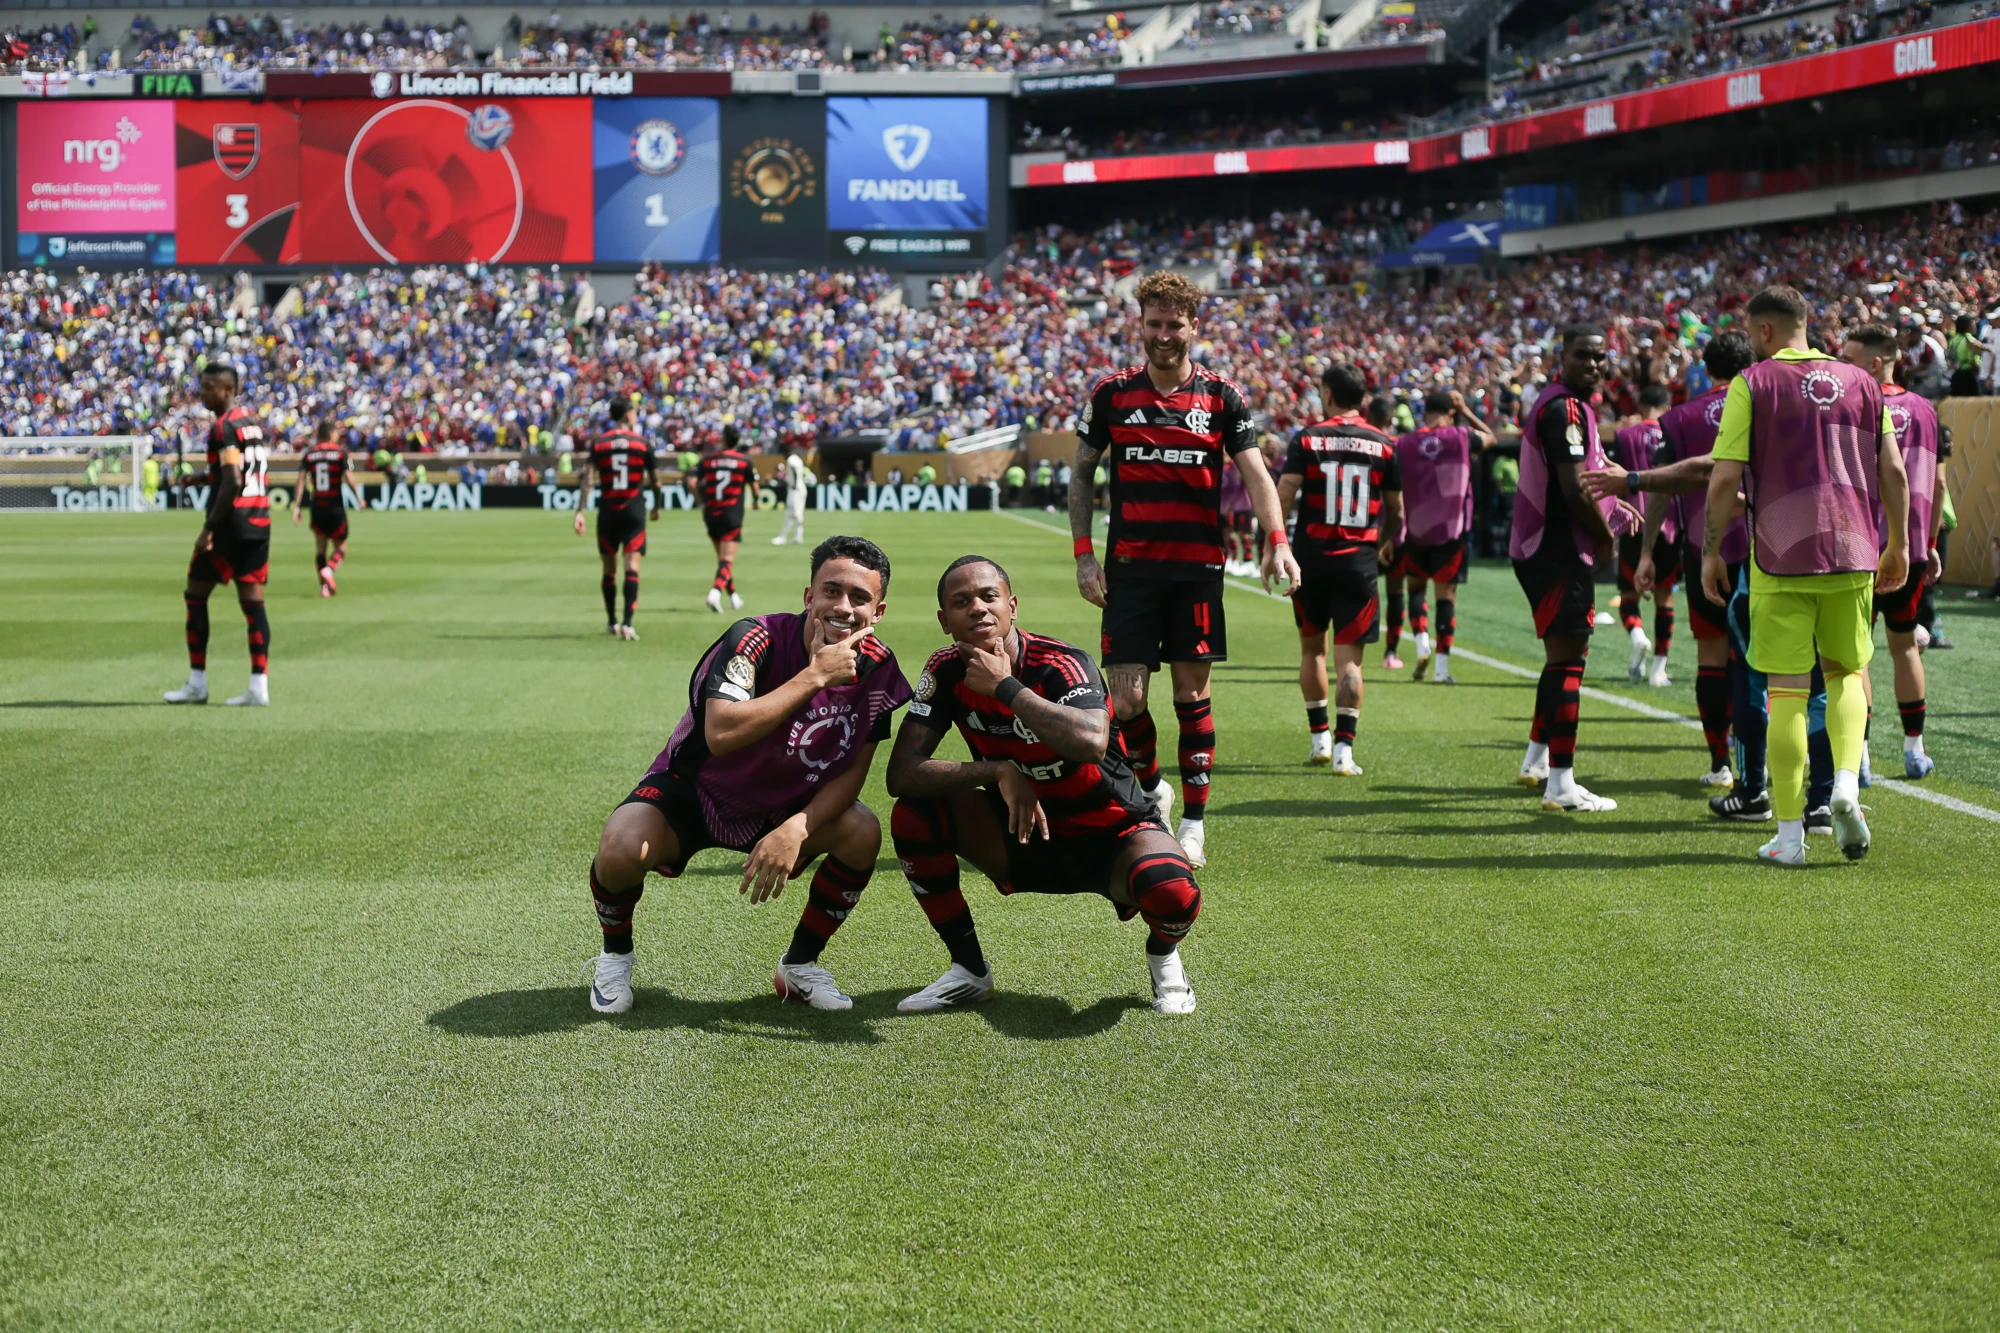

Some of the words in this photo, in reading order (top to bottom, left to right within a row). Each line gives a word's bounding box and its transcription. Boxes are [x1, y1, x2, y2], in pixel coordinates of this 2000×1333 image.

[1893, 36, 1937, 77] GOAL
[141, 74, 195, 95] FIFA
[400, 72, 479, 95] Lincoln
[481, 73, 578, 95] Financial
[579, 73, 634, 95] Field
[1726, 73, 1765, 107] GOAL
[1584, 103, 1617, 136] GOAL
[63, 137, 121, 172] nrg
[1460, 128, 1491, 160] GOAL
[847, 179, 966, 202] FANDUEL
[224, 193, 250, 229] 3
[644, 192, 670, 227] 1
[1125, 446, 1207, 465] FLABET
[1310, 436, 1325, 451] DE
[315, 461, 331, 492] 6
[611, 453, 629, 490] 5
[715, 470, 731, 501] 7
[370, 482, 481, 511] JAPAN
[817, 484, 852, 511] IN
[858, 484, 968, 511] JAPAN
[1319, 460, 1371, 528] 10
[1193, 602, 1210, 635] 4
[787, 721, 804, 755] CLUB
